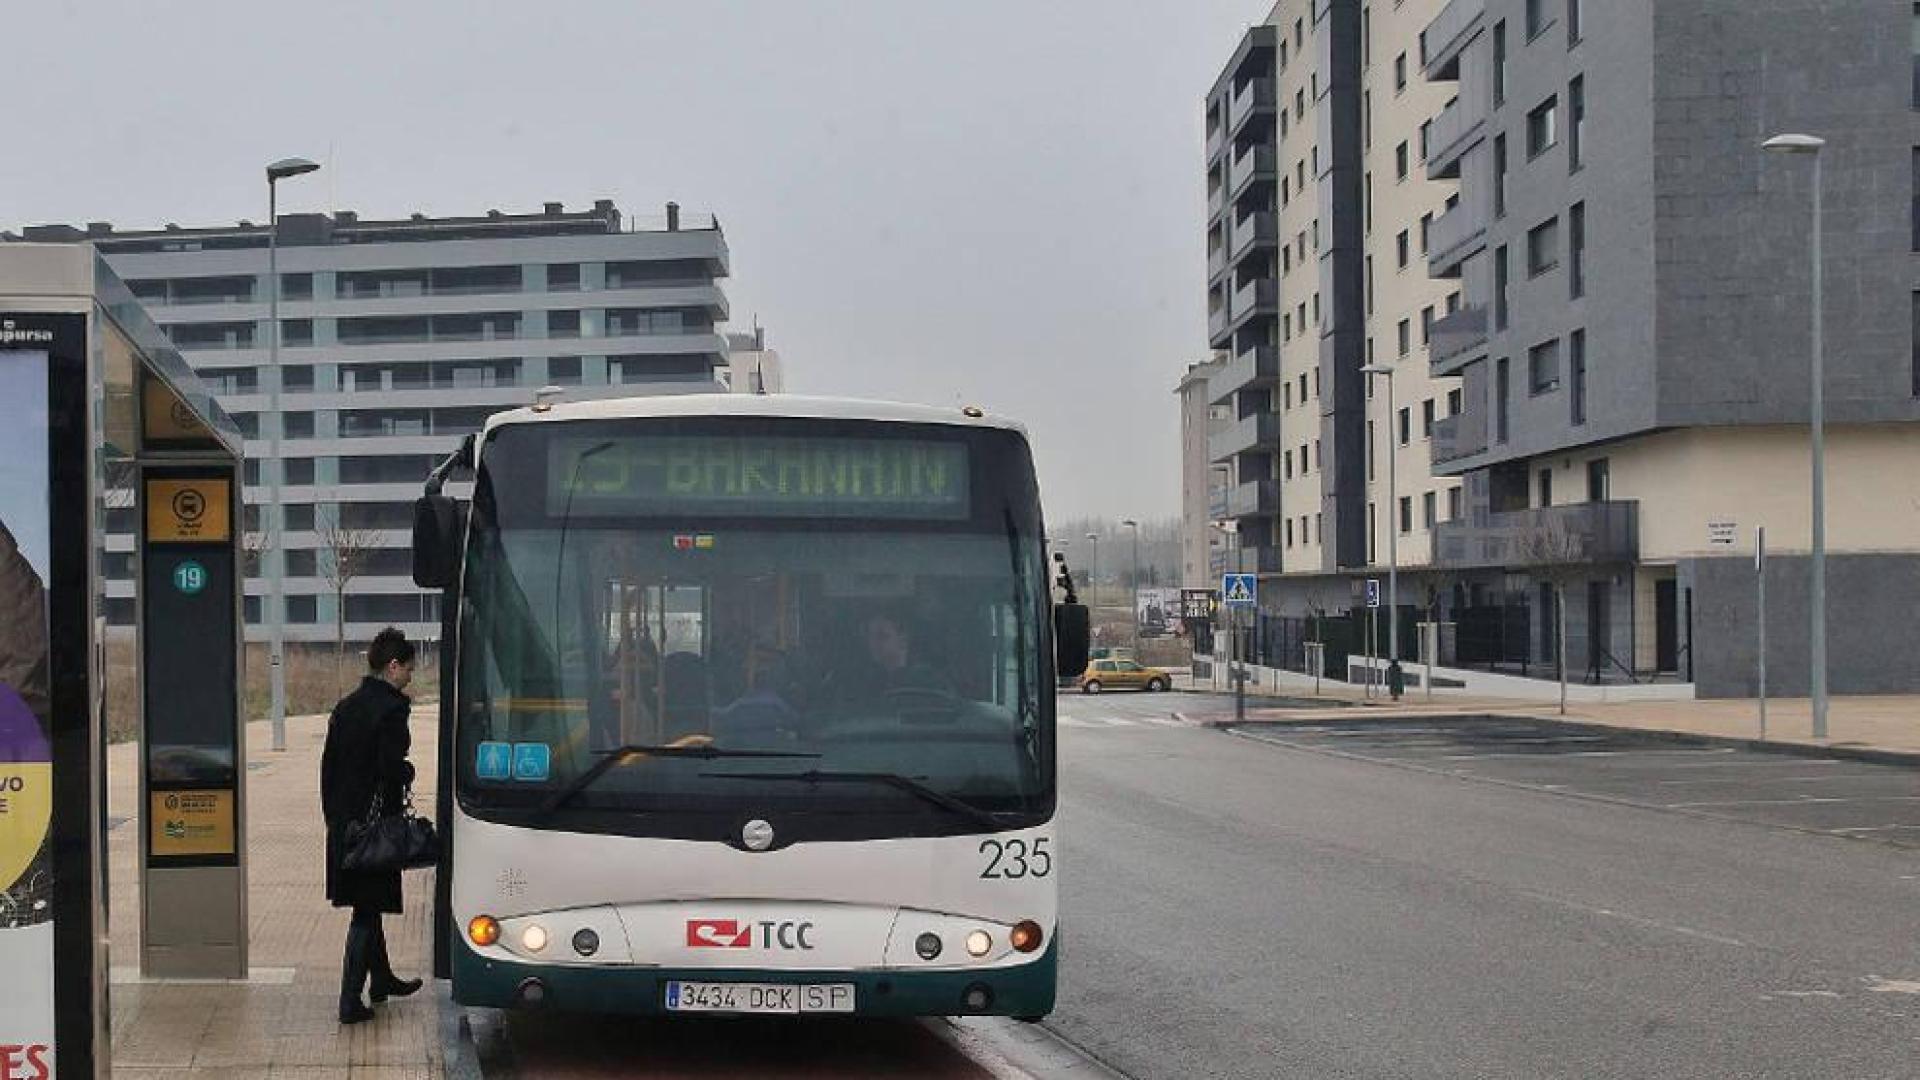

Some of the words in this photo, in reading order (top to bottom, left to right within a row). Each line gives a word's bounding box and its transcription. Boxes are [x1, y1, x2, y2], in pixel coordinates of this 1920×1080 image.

[177, 567, 201, 589] 19
[979, 837, 1051, 878] 235
[759, 920, 814, 949] TCC
[682, 984, 736, 1009] 3434
[750, 987, 792, 1009] DCK
